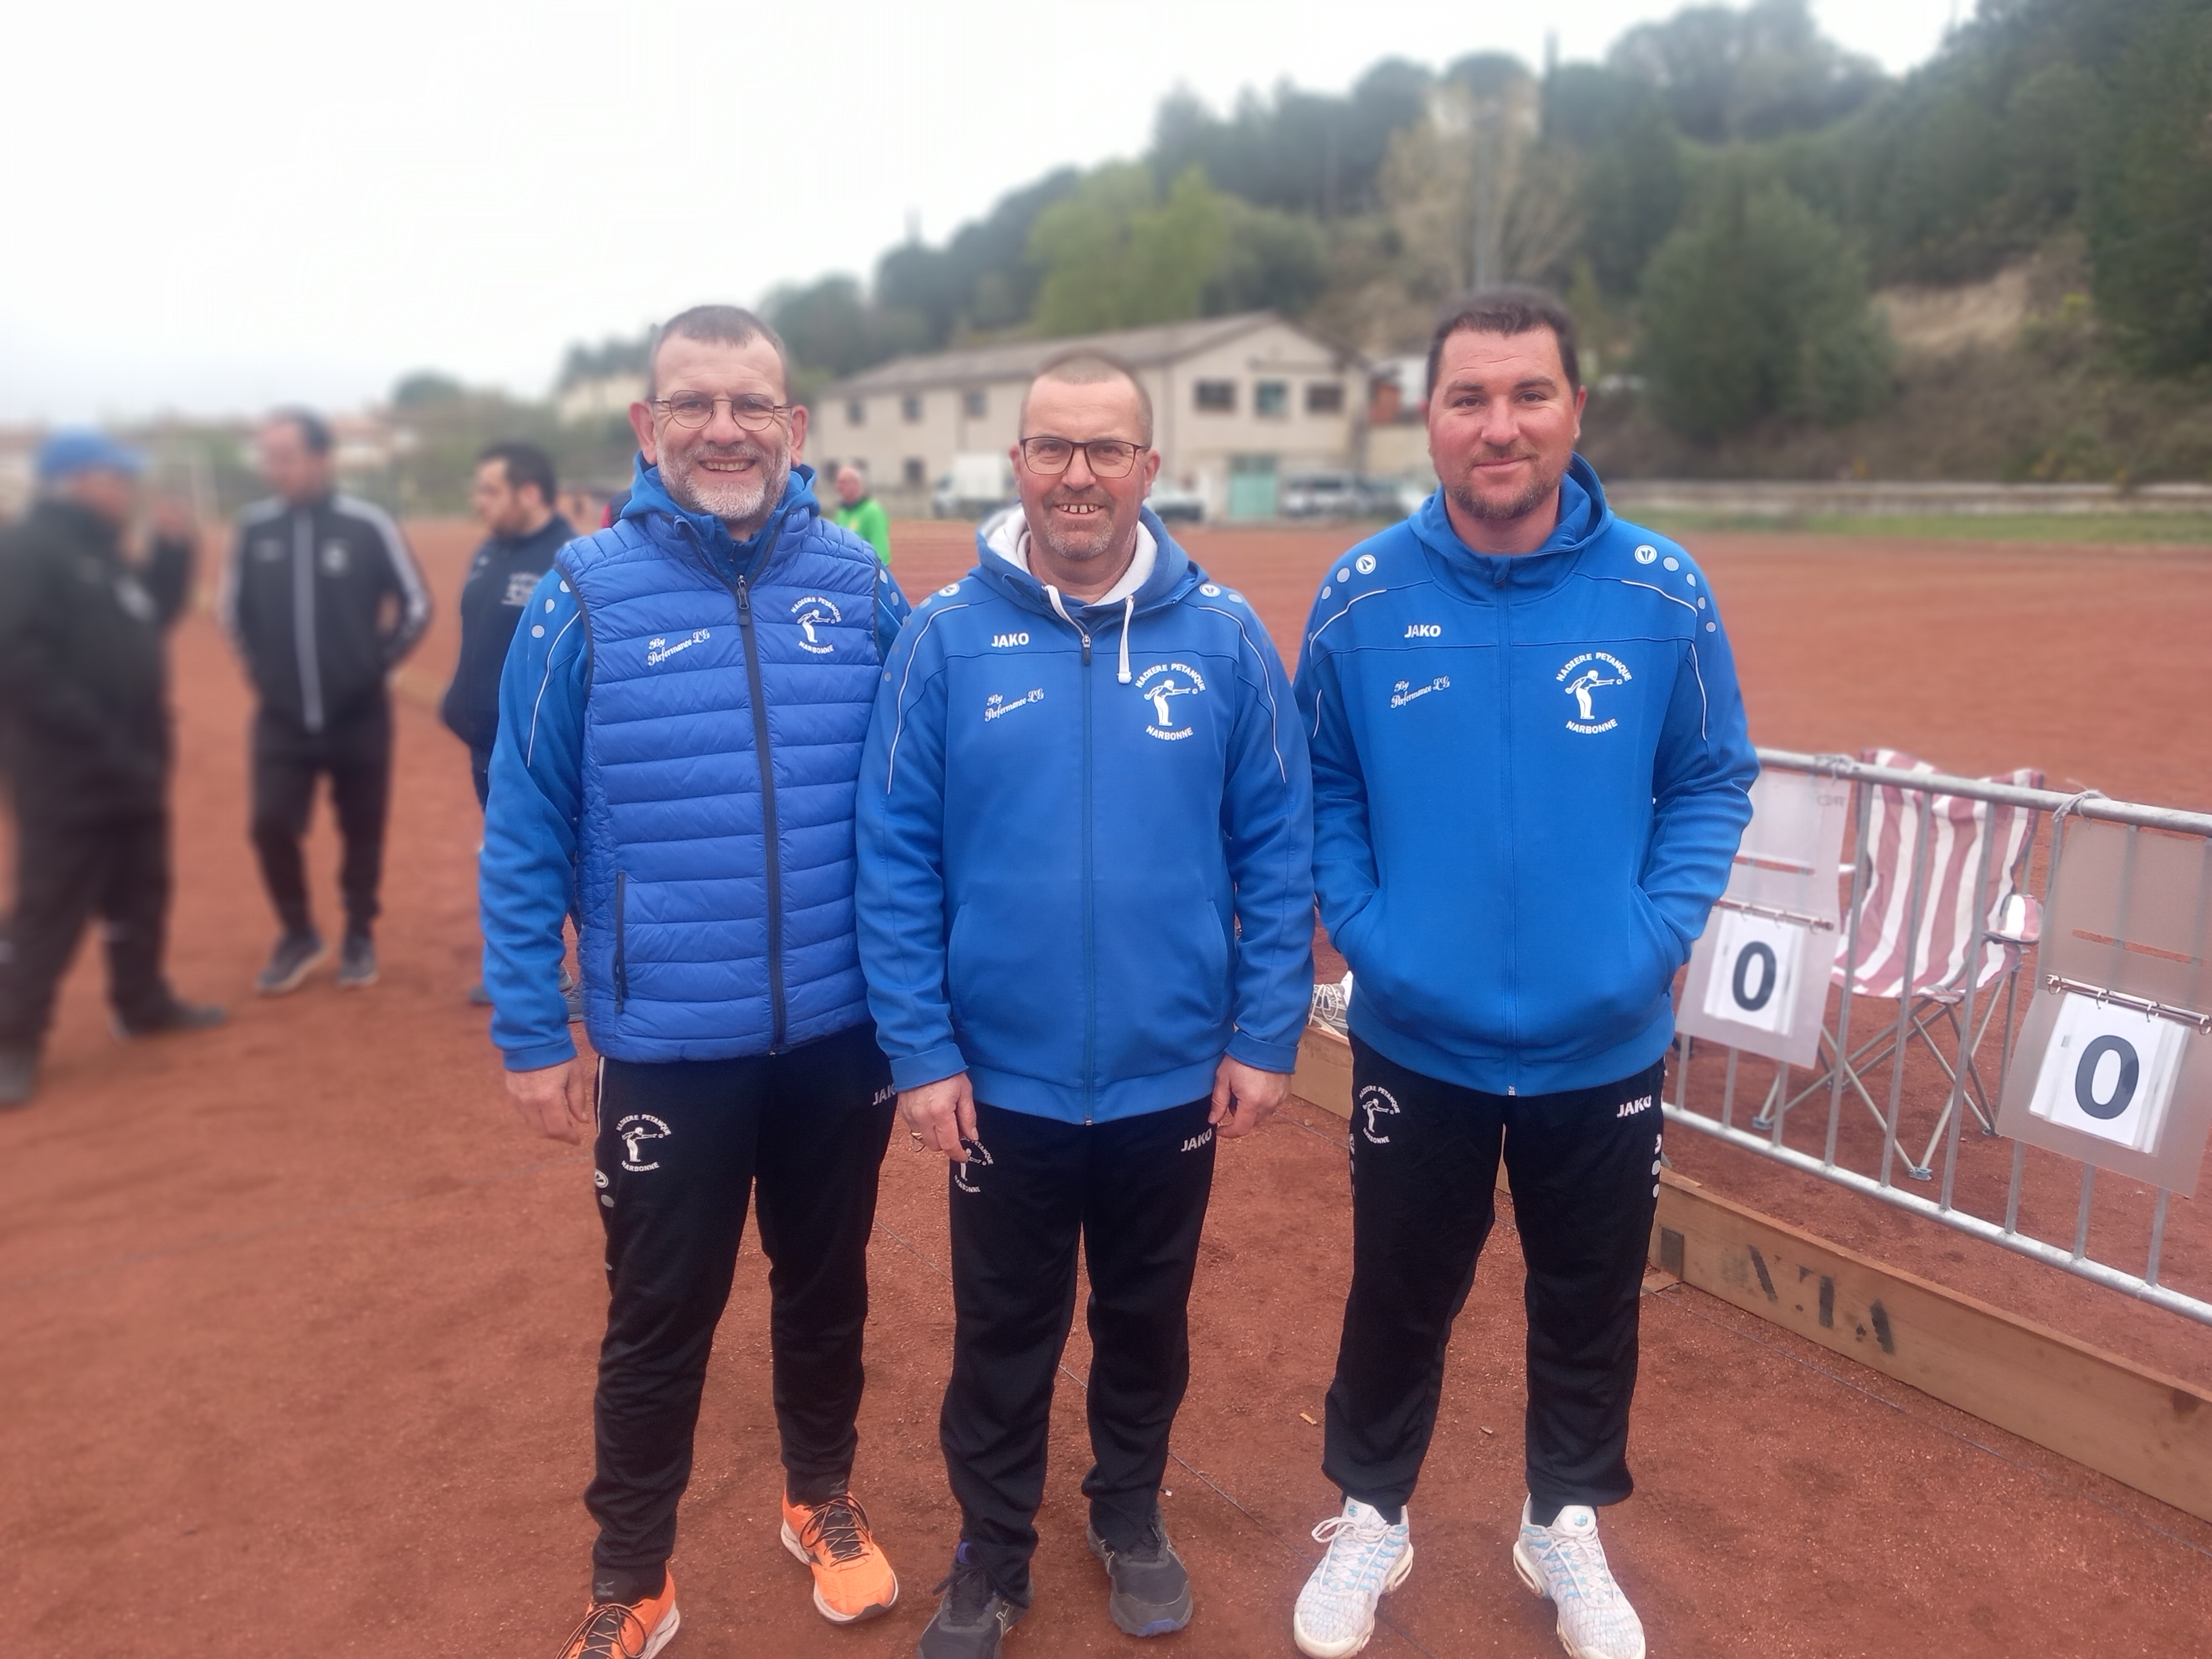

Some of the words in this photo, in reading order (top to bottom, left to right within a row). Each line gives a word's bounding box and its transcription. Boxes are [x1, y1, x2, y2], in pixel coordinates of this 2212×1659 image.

[817, 596, 842, 623] PETANQUE
[991, 632, 1029, 648] JAKO
[1404, 624, 1441, 638] JAKO
[649, 638, 665, 650] By
[798, 640, 834, 654] NARBONNE
[1134, 663, 1168, 689] NADIERE
[1170, 662, 1206, 692] PETANQUE
[1555, 653, 1593, 682] NADIERE
[1595, 651, 1633, 682] PETANQUE
[1393, 680, 1410, 693] By
[987, 693, 1003, 706] By
[1145, 724, 1193, 741] NARBONNE
[1565, 718, 1618, 735] NARBONNE
[1732, 941, 1776, 1011] 0
[2074, 1035, 2139, 1120] 0
[872, 1083, 896, 1106] JAK
[1377, 1086, 1401, 1113] PETANQUE
[1616, 1094, 1652, 1118] JAKO
[615, 1114, 639, 1132] NADIERE
[641, 1113, 672, 1136] PETANQUE
[1181, 1128, 1212, 1152] JAKO
[971, 1140, 994, 1165] ETANQUE
[621, 1160, 660, 1172] NARBONNE
